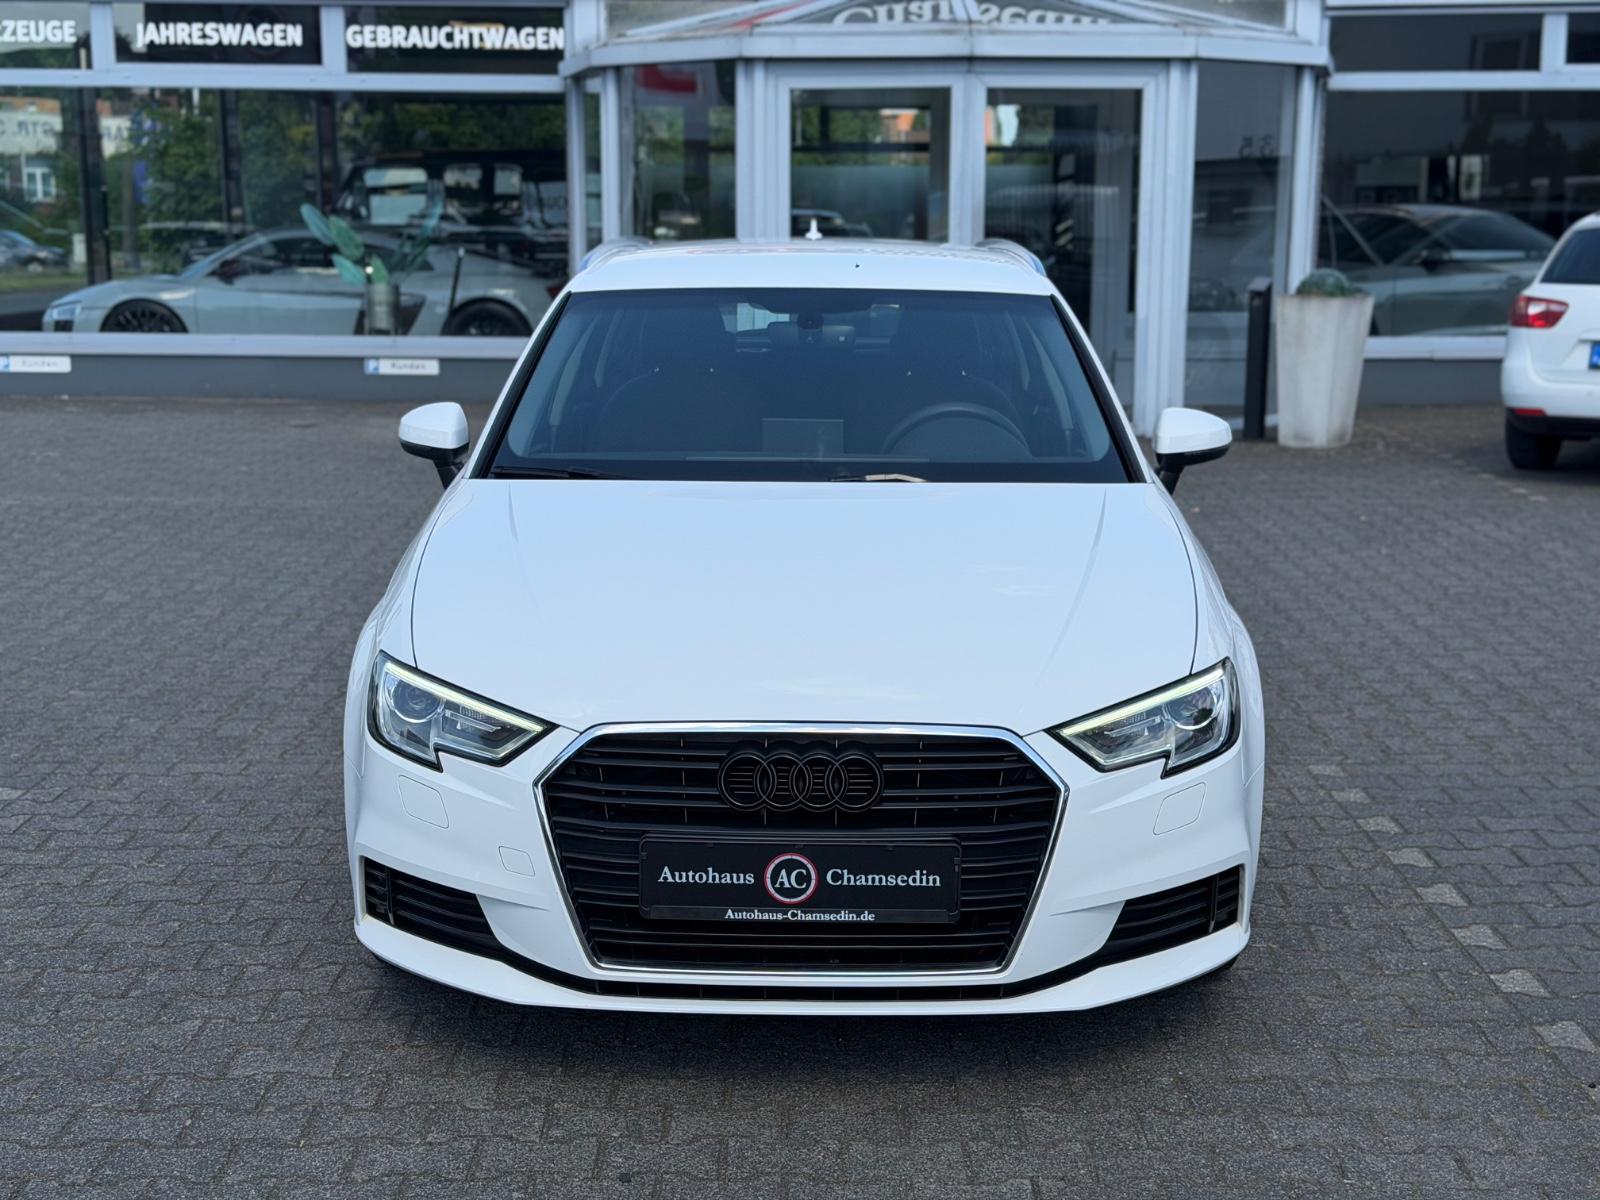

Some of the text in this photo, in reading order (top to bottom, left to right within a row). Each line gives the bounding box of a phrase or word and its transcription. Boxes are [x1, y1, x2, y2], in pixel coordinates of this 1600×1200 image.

[0, 19, 77, 43] ZEUGE
[135, 22, 303, 47] JAHRESWAGEN
[346, 24, 565, 50] GEBRAUCHTWAGEN
[657, 866, 942, 889] Autohaus AC Chamsedin
[724, 909, 876, 922] Autohaus-Chamsedin.de
